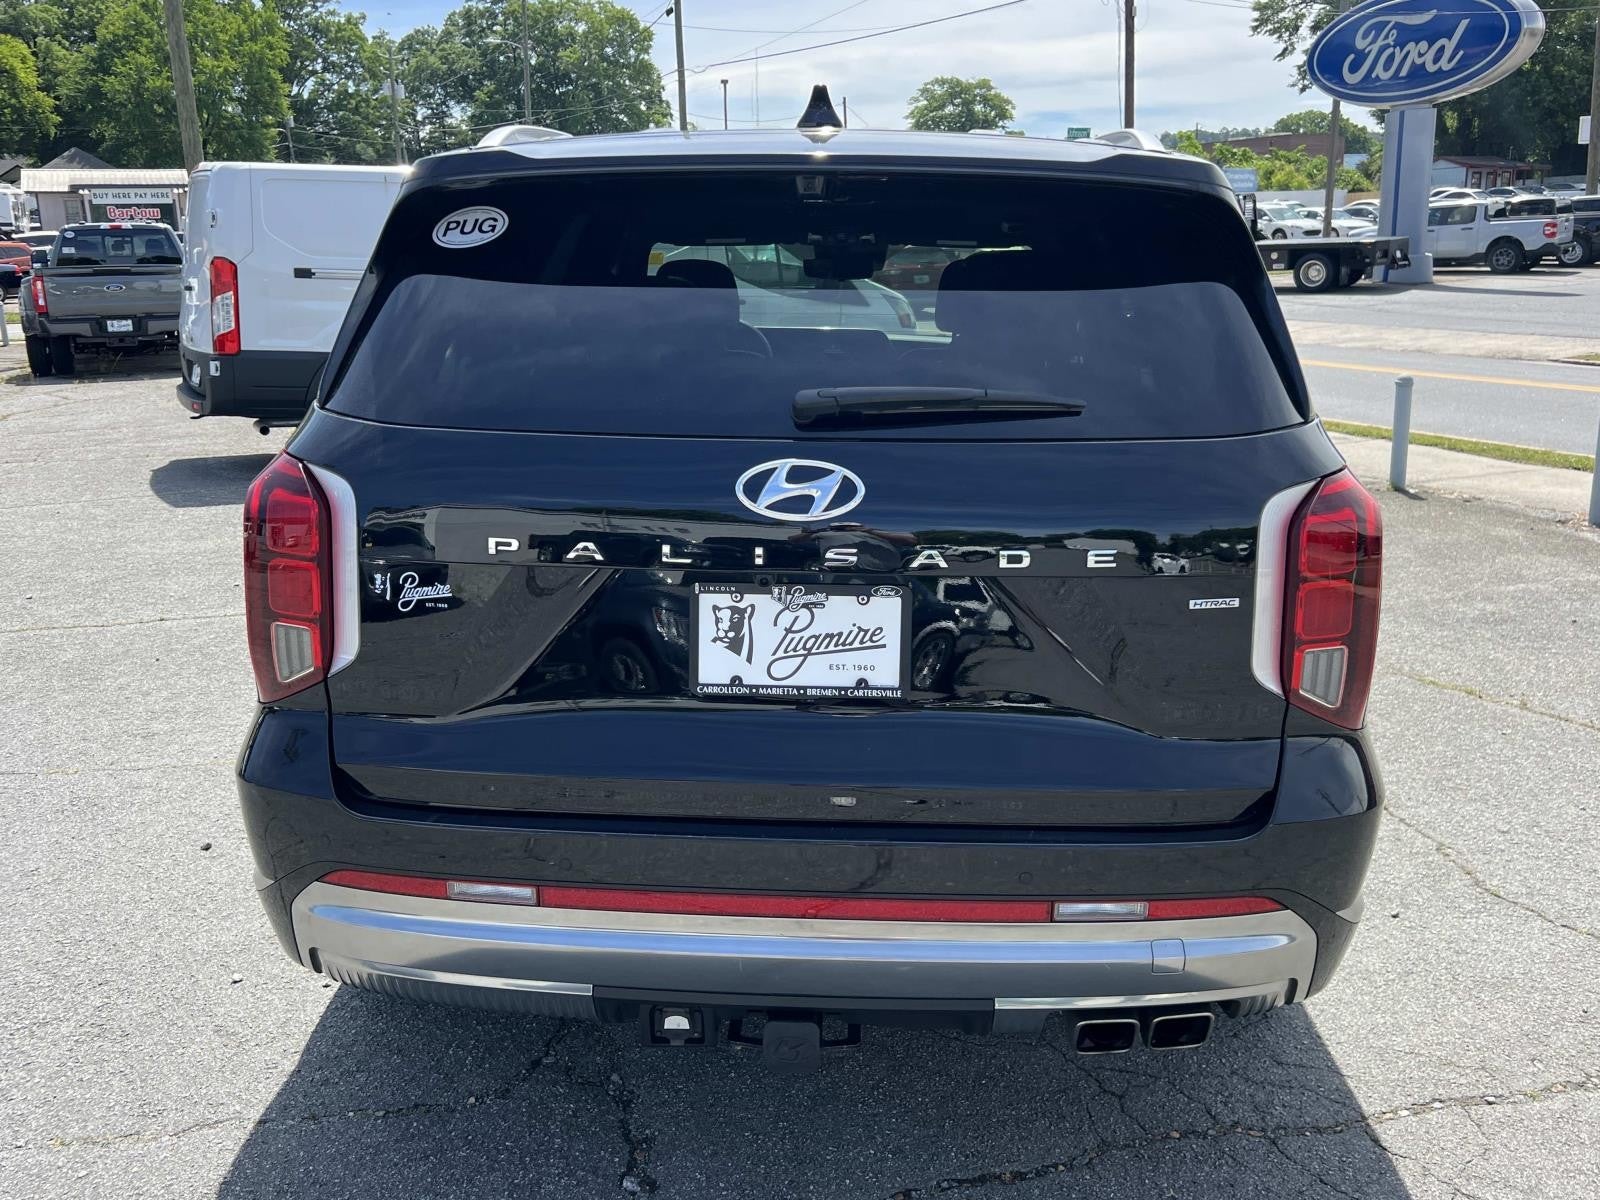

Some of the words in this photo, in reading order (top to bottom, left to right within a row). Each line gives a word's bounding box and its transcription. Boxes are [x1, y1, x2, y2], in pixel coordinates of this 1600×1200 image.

[1342, 9, 1471, 85] Ford
[92, 191, 109, 199] BUY
[111, 191, 131, 199] HERE
[134, 191, 147, 199] PAY
[150, 191, 170, 199] HERE
[106, 205, 161, 219] Bartow
[442, 216, 499, 237] PUG
[487, 536, 1118, 568] PALISADE
[397, 571, 452, 612] Pugmire
[789, 585, 828, 612] Pugmire
[1193, 599, 1236, 608] HTRAC
[766, 606, 887, 682] Pugmire
[852, 664, 876, 672] 1960
[696, 685, 750, 694] CARROLLTON
[758, 687, 798, 696] MARIETTA
[806, 688, 839, 696] BREMEN
[847, 688, 902, 698] CARTERSVILLE
